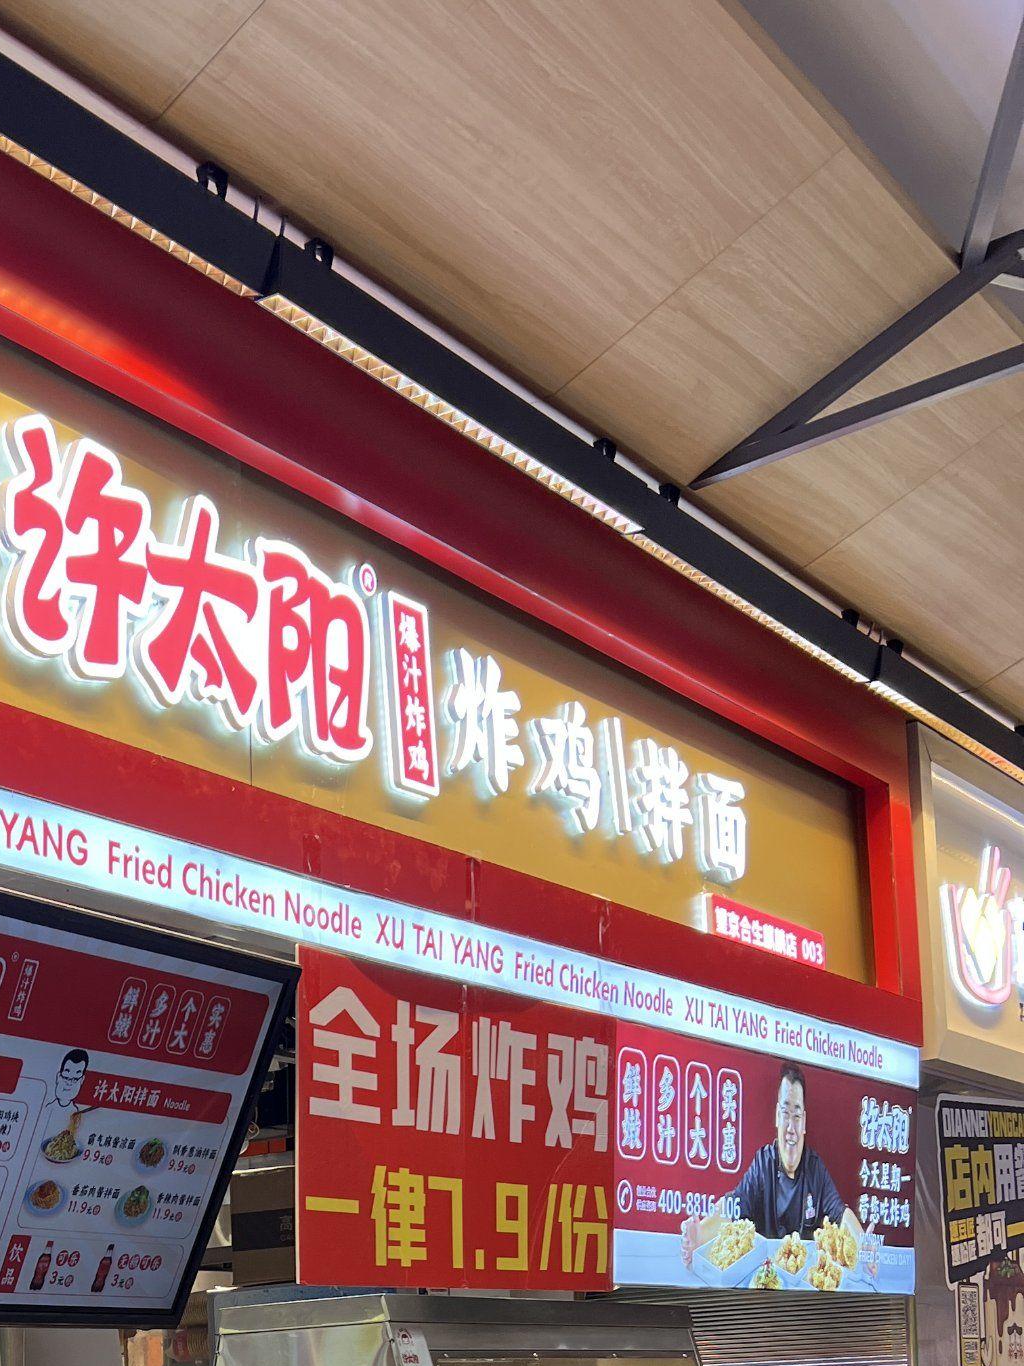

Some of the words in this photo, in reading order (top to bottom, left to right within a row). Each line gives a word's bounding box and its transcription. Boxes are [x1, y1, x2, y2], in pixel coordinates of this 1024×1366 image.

[397, 611, 431, 783] 爆汁炸鸡
[107, 840, 172, 890] Fried
[182, 861, 275, 918] Chicken
[284, 889, 362, 940] Noodle
[376, 913, 405, 951] XU
[413, 923, 443, 961] TAI
[450, 932, 505, 974] YANG
[515, 951, 554, 989] Fried
[559, 963, 619, 1005] Chicken
[624, 981, 674, 1018] Noodle
[684, 996, 705, 1023] XU
[708, 1001, 729, 1029] TAI
[732, 1006, 769, 1040] YANG
[774, 1020, 802, 1049] Fried
[805, 1028, 845, 1062] Chicken
[848, 1040, 883, 1070] Noodle
[801, 938, 824, 965] 003
[143, 991, 169, 1046] 多汁
[169, 996, 197, 1050] 个大
[199, 1003, 224, 1054] 实惠
[93, 1080, 160, 1108] 许太阳拌面
[163, 1098, 190, 1112] Noodle
[309, 986, 608, 1153] 全场炸鸡
[657, 1066, 676, 1158] 多汁
[690, 1073, 708, 1160] 个大
[721, 1079, 737, 1164] 实惠
[860, 1096, 910, 1154] 许太阳
[859, 1158, 912, 1193] 今天星期一
[658, 1190, 741, 1219] 400-8816-106
